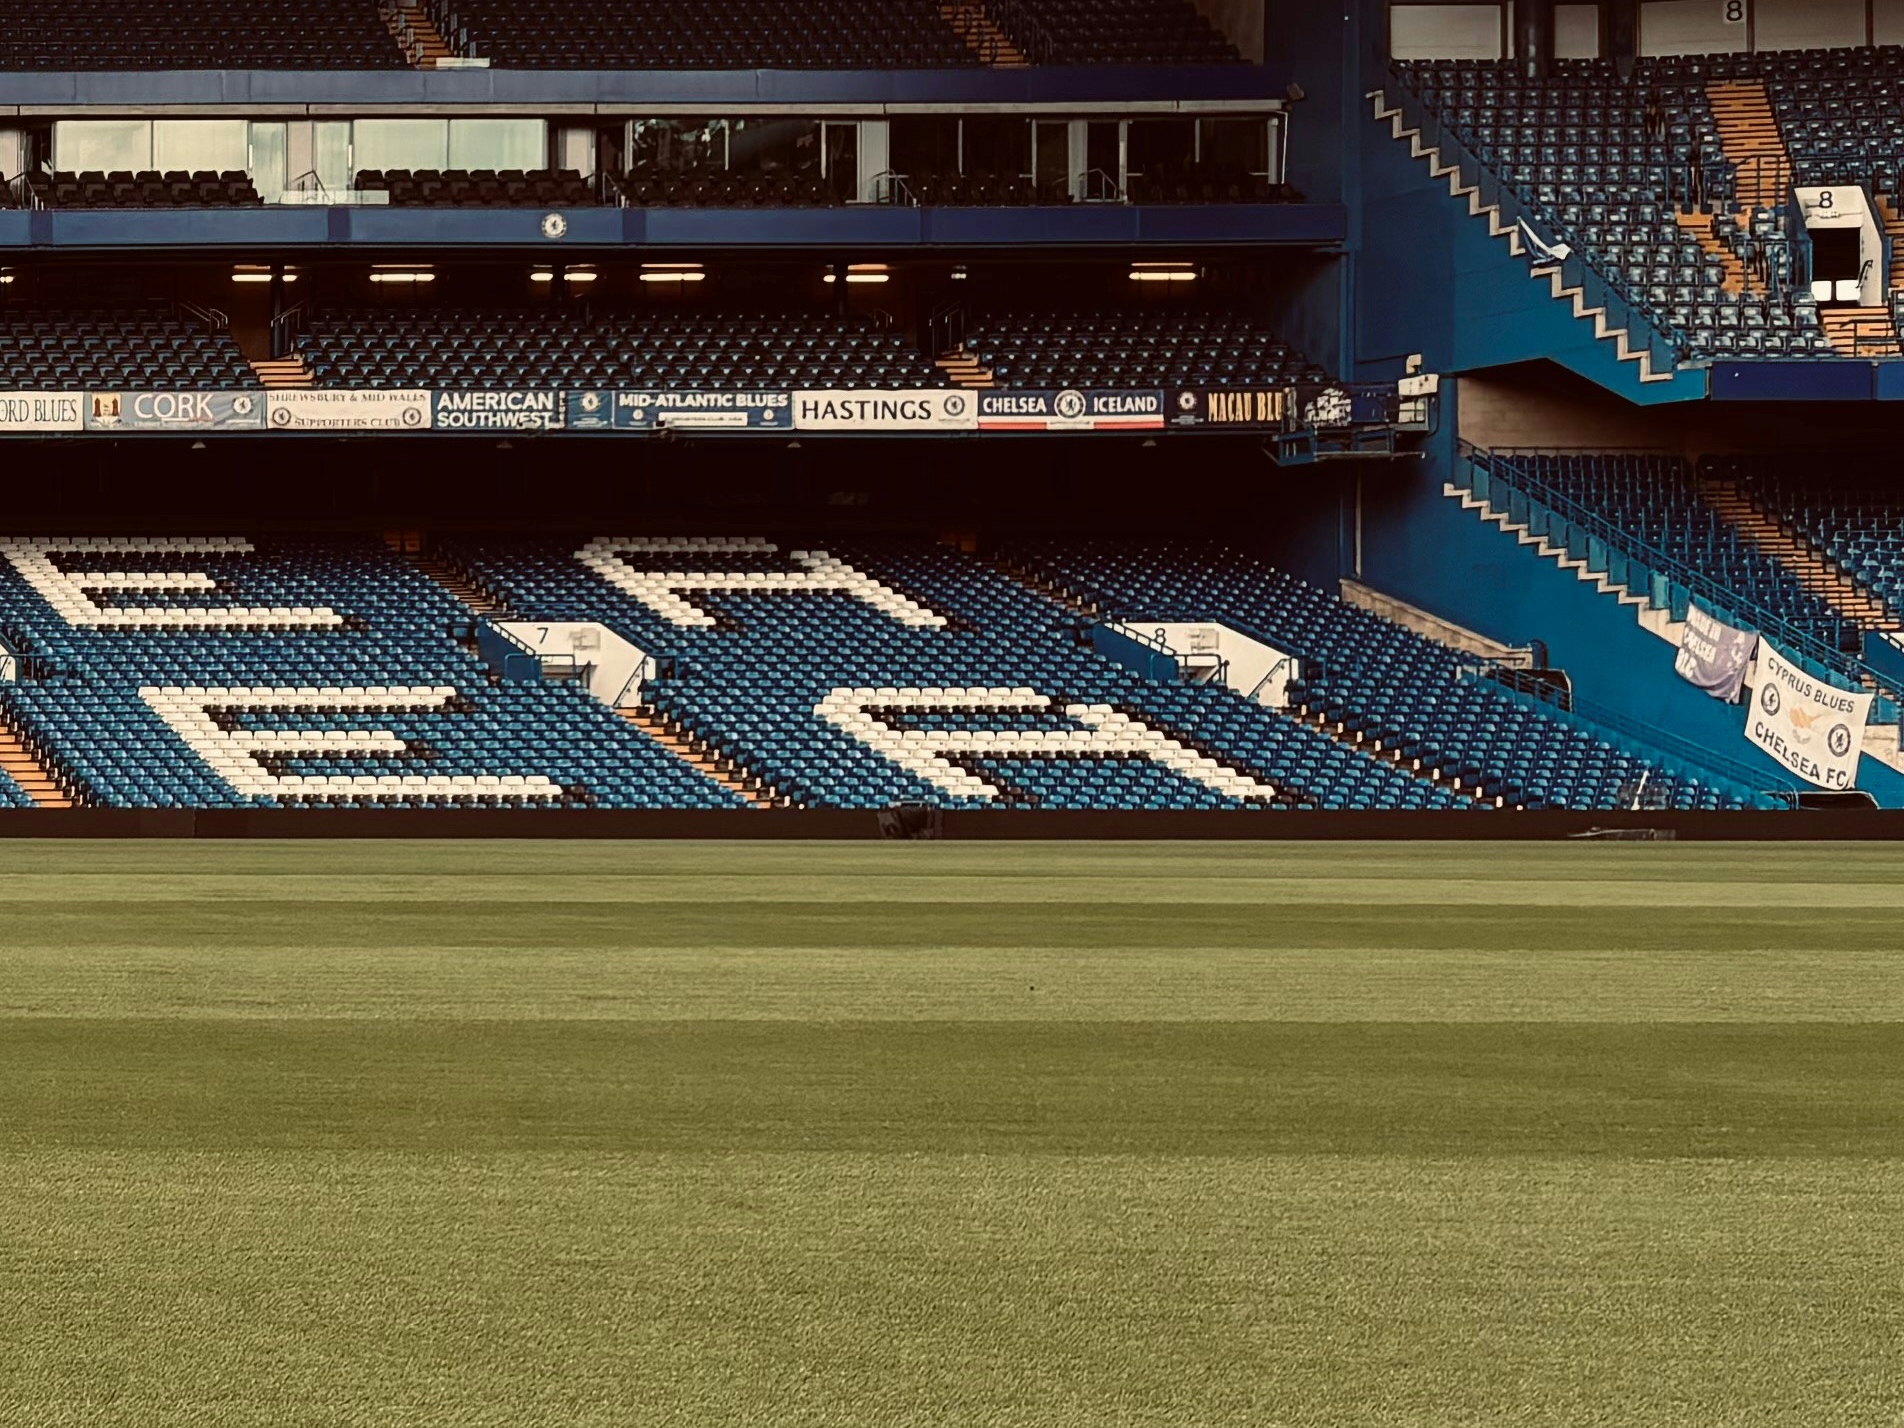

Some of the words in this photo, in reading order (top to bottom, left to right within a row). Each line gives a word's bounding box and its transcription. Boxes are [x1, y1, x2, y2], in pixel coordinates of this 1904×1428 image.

[1726, 0, 1742, 21] 8
[1819, 191, 1833, 208] 8
[134, 393, 213, 420] CORK
[361, 393, 385, 403] MID
[437, 392, 554, 410] AMERICAN
[619, 394, 733, 407] MID-ATLANTIC
[736, 394, 788, 407] BLUES
[983, 396, 1047, 414] CHELSEA
[1094, 395, 1158, 414] ICELAND
[1208, 392, 1252, 422] MACAU
[33, 399, 77, 423] BLUES
[437, 410, 551, 428] SOUTHWEST
[801, 399, 932, 421] HASTINGS
[536, 627, 549, 644] 7
[1154, 627, 1167, 645] 8
[1768, 657, 1812, 697] CYPRUS
[1813, 689, 1855, 714] BLUES
[1755, 721, 1821, 782] CHELSEA
[1826, 767, 1847, 787] FC
